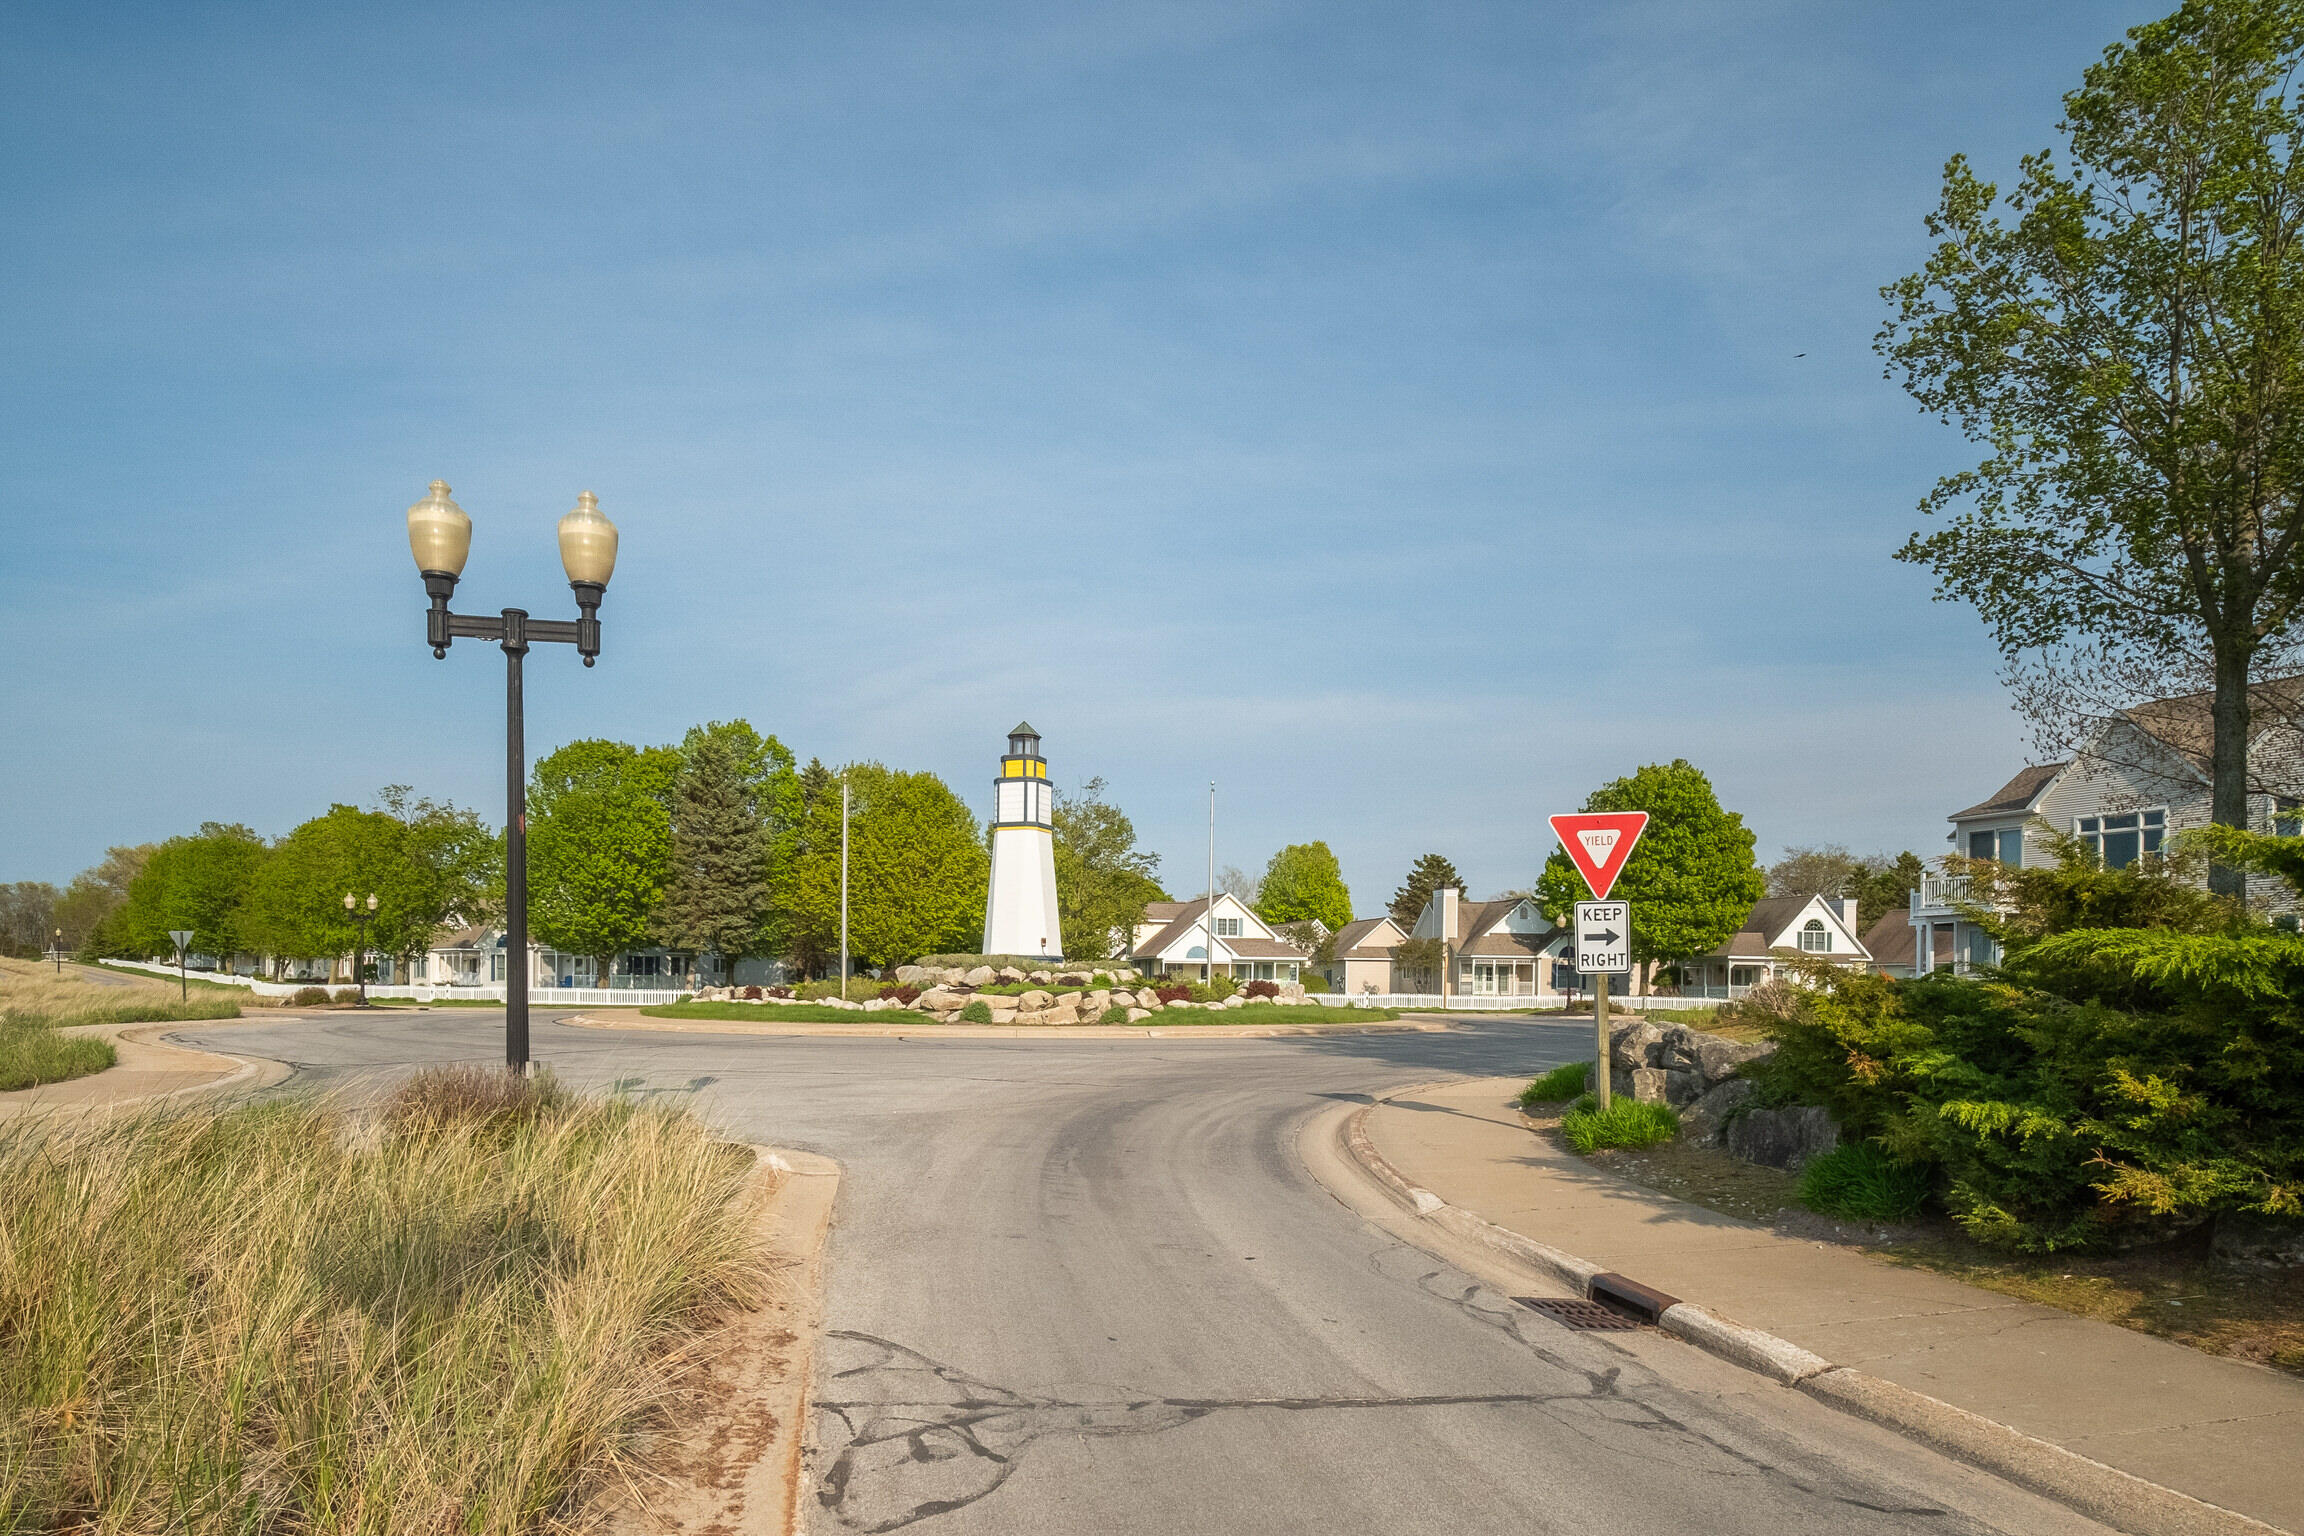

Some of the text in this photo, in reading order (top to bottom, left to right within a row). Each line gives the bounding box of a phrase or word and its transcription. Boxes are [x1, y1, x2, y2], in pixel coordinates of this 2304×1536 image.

[1585, 835, 1613, 846] YIELD
[1583, 908, 1622, 921] KEEP
[1581, 953, 1626, 967] RIGHT
